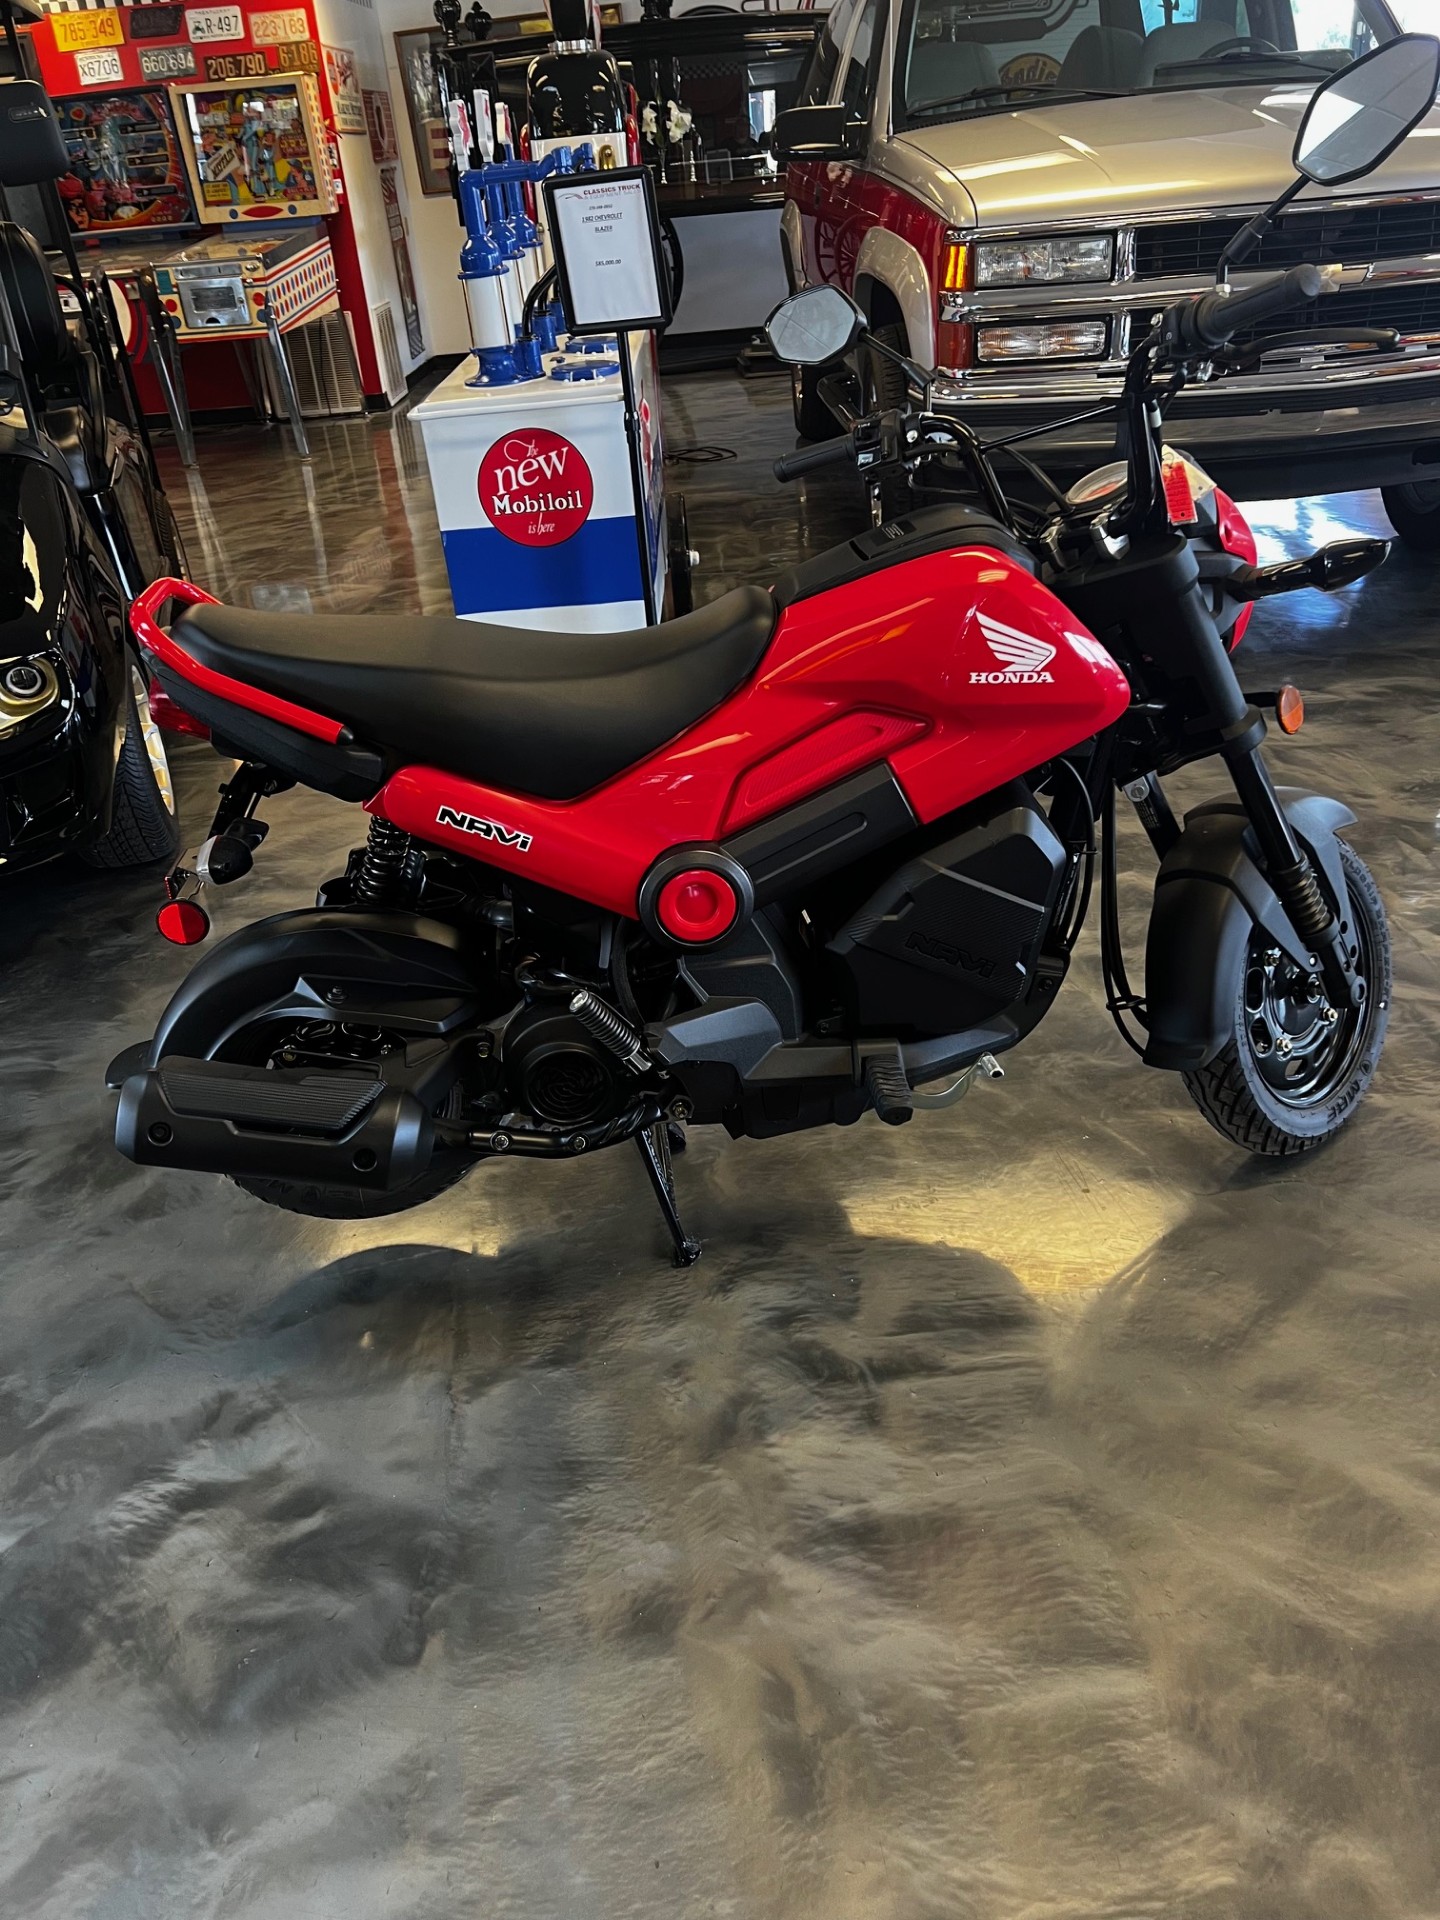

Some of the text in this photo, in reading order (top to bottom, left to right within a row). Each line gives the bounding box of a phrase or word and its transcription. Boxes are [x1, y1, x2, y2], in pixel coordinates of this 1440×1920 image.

[583, 186, 616, 195] CLASSICS
[594, 212, 623, 221] CHEVROLET
[504, 439, 539, 462] The
[494, 446, 569, 496] new
[492, 490, 583, 516] Mobiloil
[528, 512, 555, 536] is here
[969, 671, 1055, 684] HONDA
[1327, 1080, 1360, 1124] MRF
